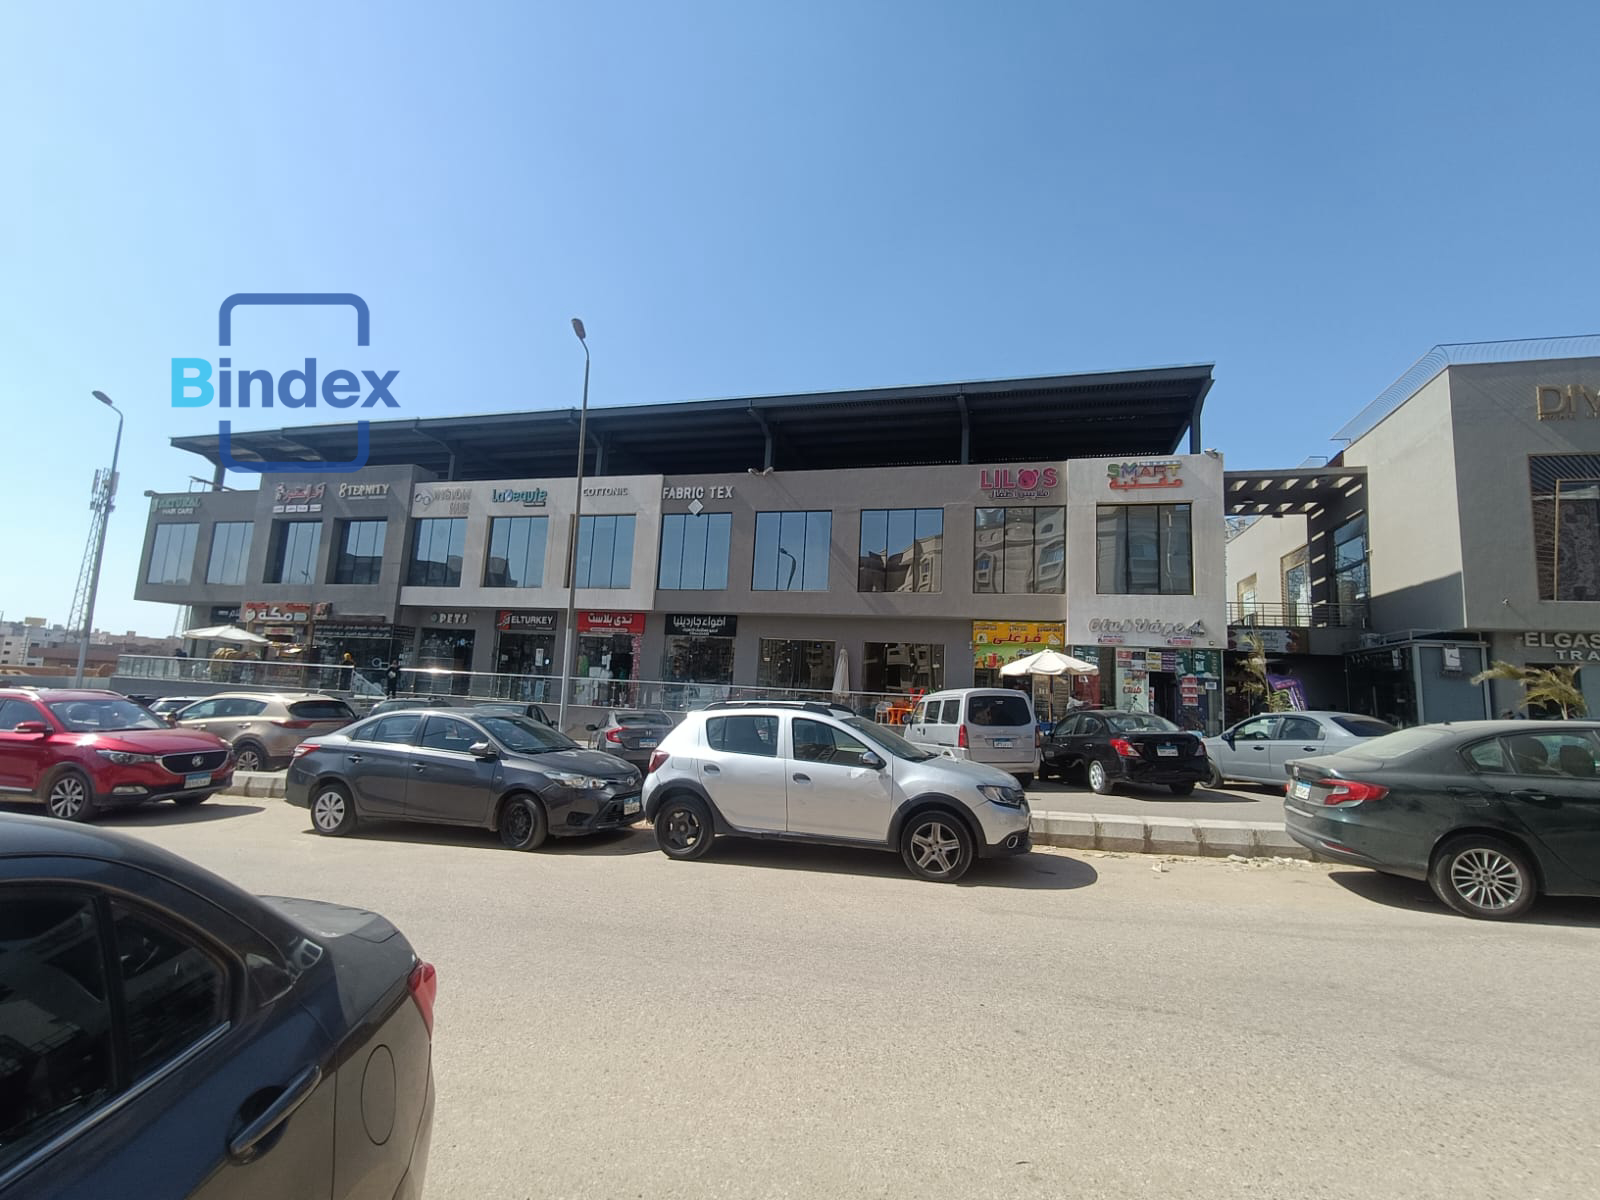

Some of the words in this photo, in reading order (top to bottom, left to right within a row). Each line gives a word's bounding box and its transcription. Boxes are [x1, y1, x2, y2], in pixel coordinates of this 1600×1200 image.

[663, 486, 705, 499] FABRIC
[710, 486, 733, 498] TEX
[439, 613, 469, 624] PETS
